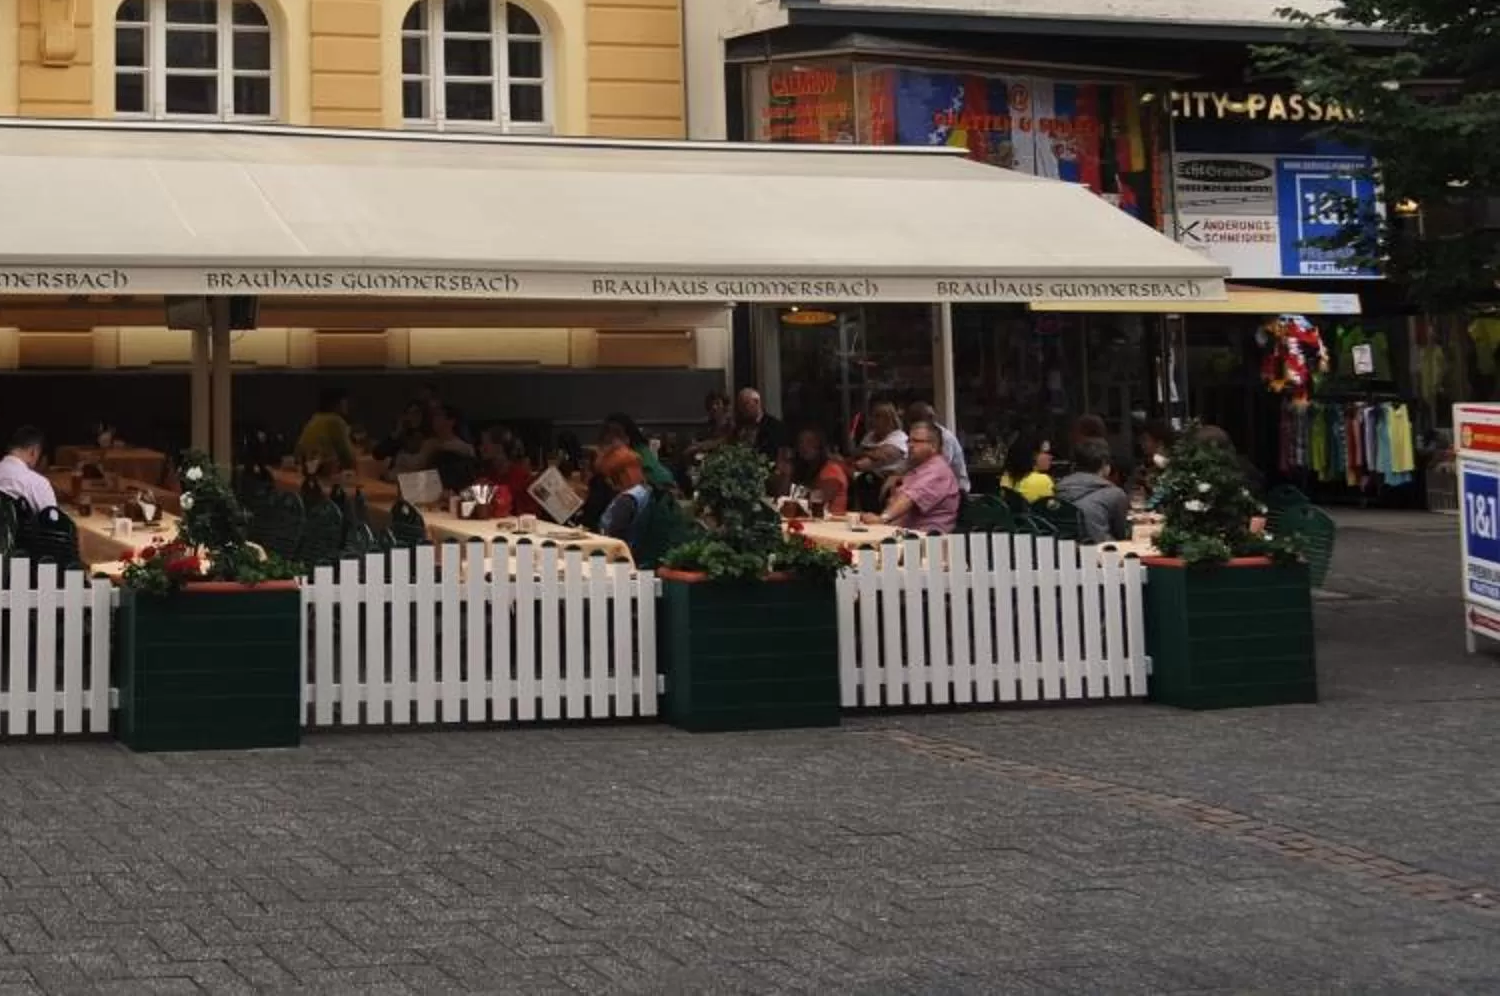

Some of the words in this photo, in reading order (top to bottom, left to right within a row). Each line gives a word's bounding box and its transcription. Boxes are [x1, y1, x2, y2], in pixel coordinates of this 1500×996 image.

[205, 269, 333, 289] BRAUHAUS
[341, 271, 520, 291] GUMMERSBACH
[592, 276, 709, 296] BRAUHAUS
[715, 279, 879, 296] GUMMERSBACH
[936, 278, 1044, 297] BRAUHAUS
[1051, 279, 1201, 298] GUMMERSBACH
[1466, 492, 1497, 540] 1&1
